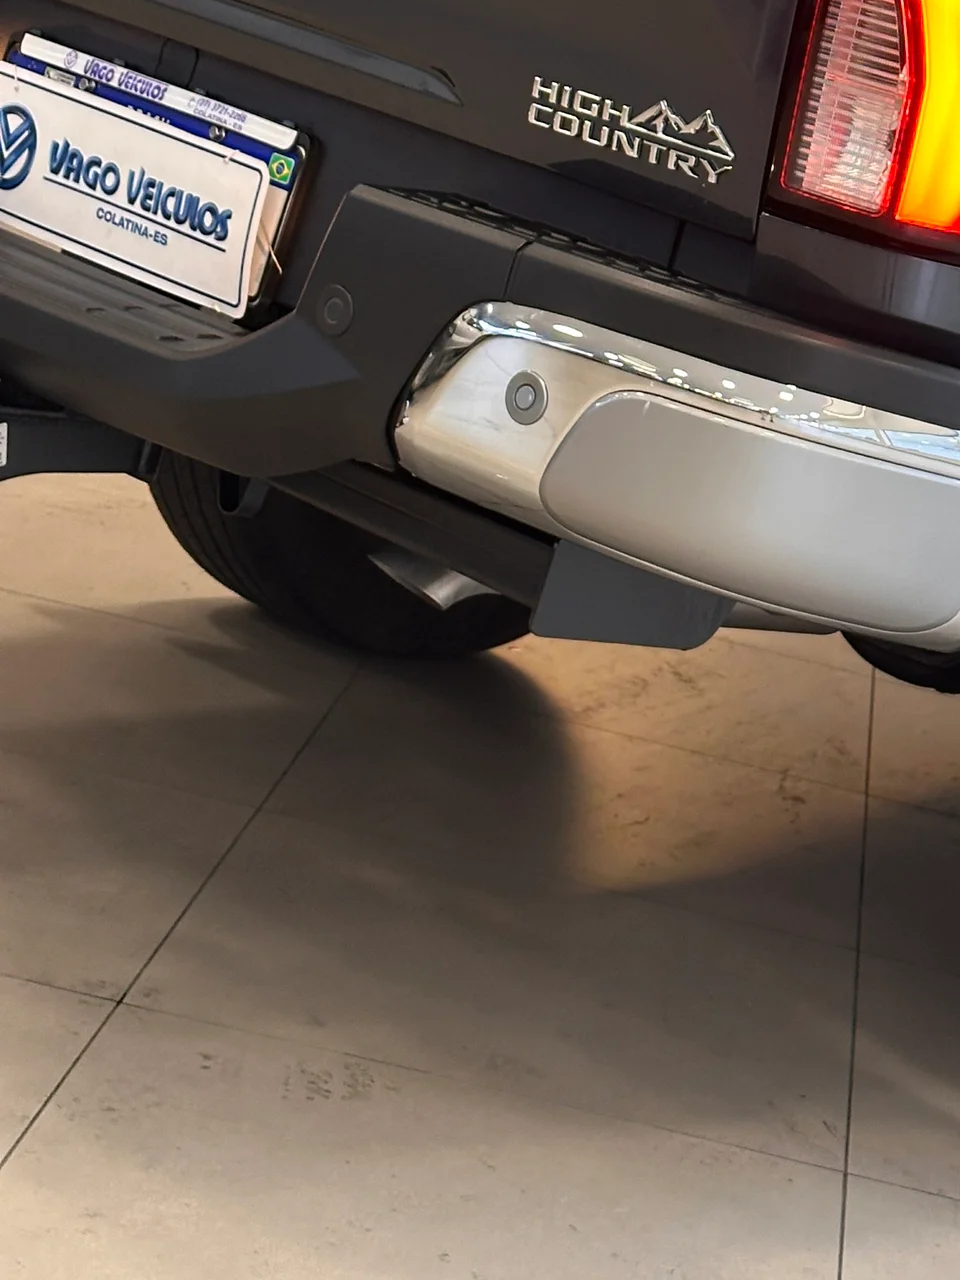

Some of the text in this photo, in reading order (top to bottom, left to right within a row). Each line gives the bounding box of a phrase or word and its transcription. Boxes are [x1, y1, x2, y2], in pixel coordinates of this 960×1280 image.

[83, 57, 115, 83] VAGO
[531, 76, 631, 127] HIGH
[528, 102, 733, 184] COUNTRY
[49, 136, 233, 242] VAGO VEICULOS
[96, 206, 169, 246] COLATINA-ES
